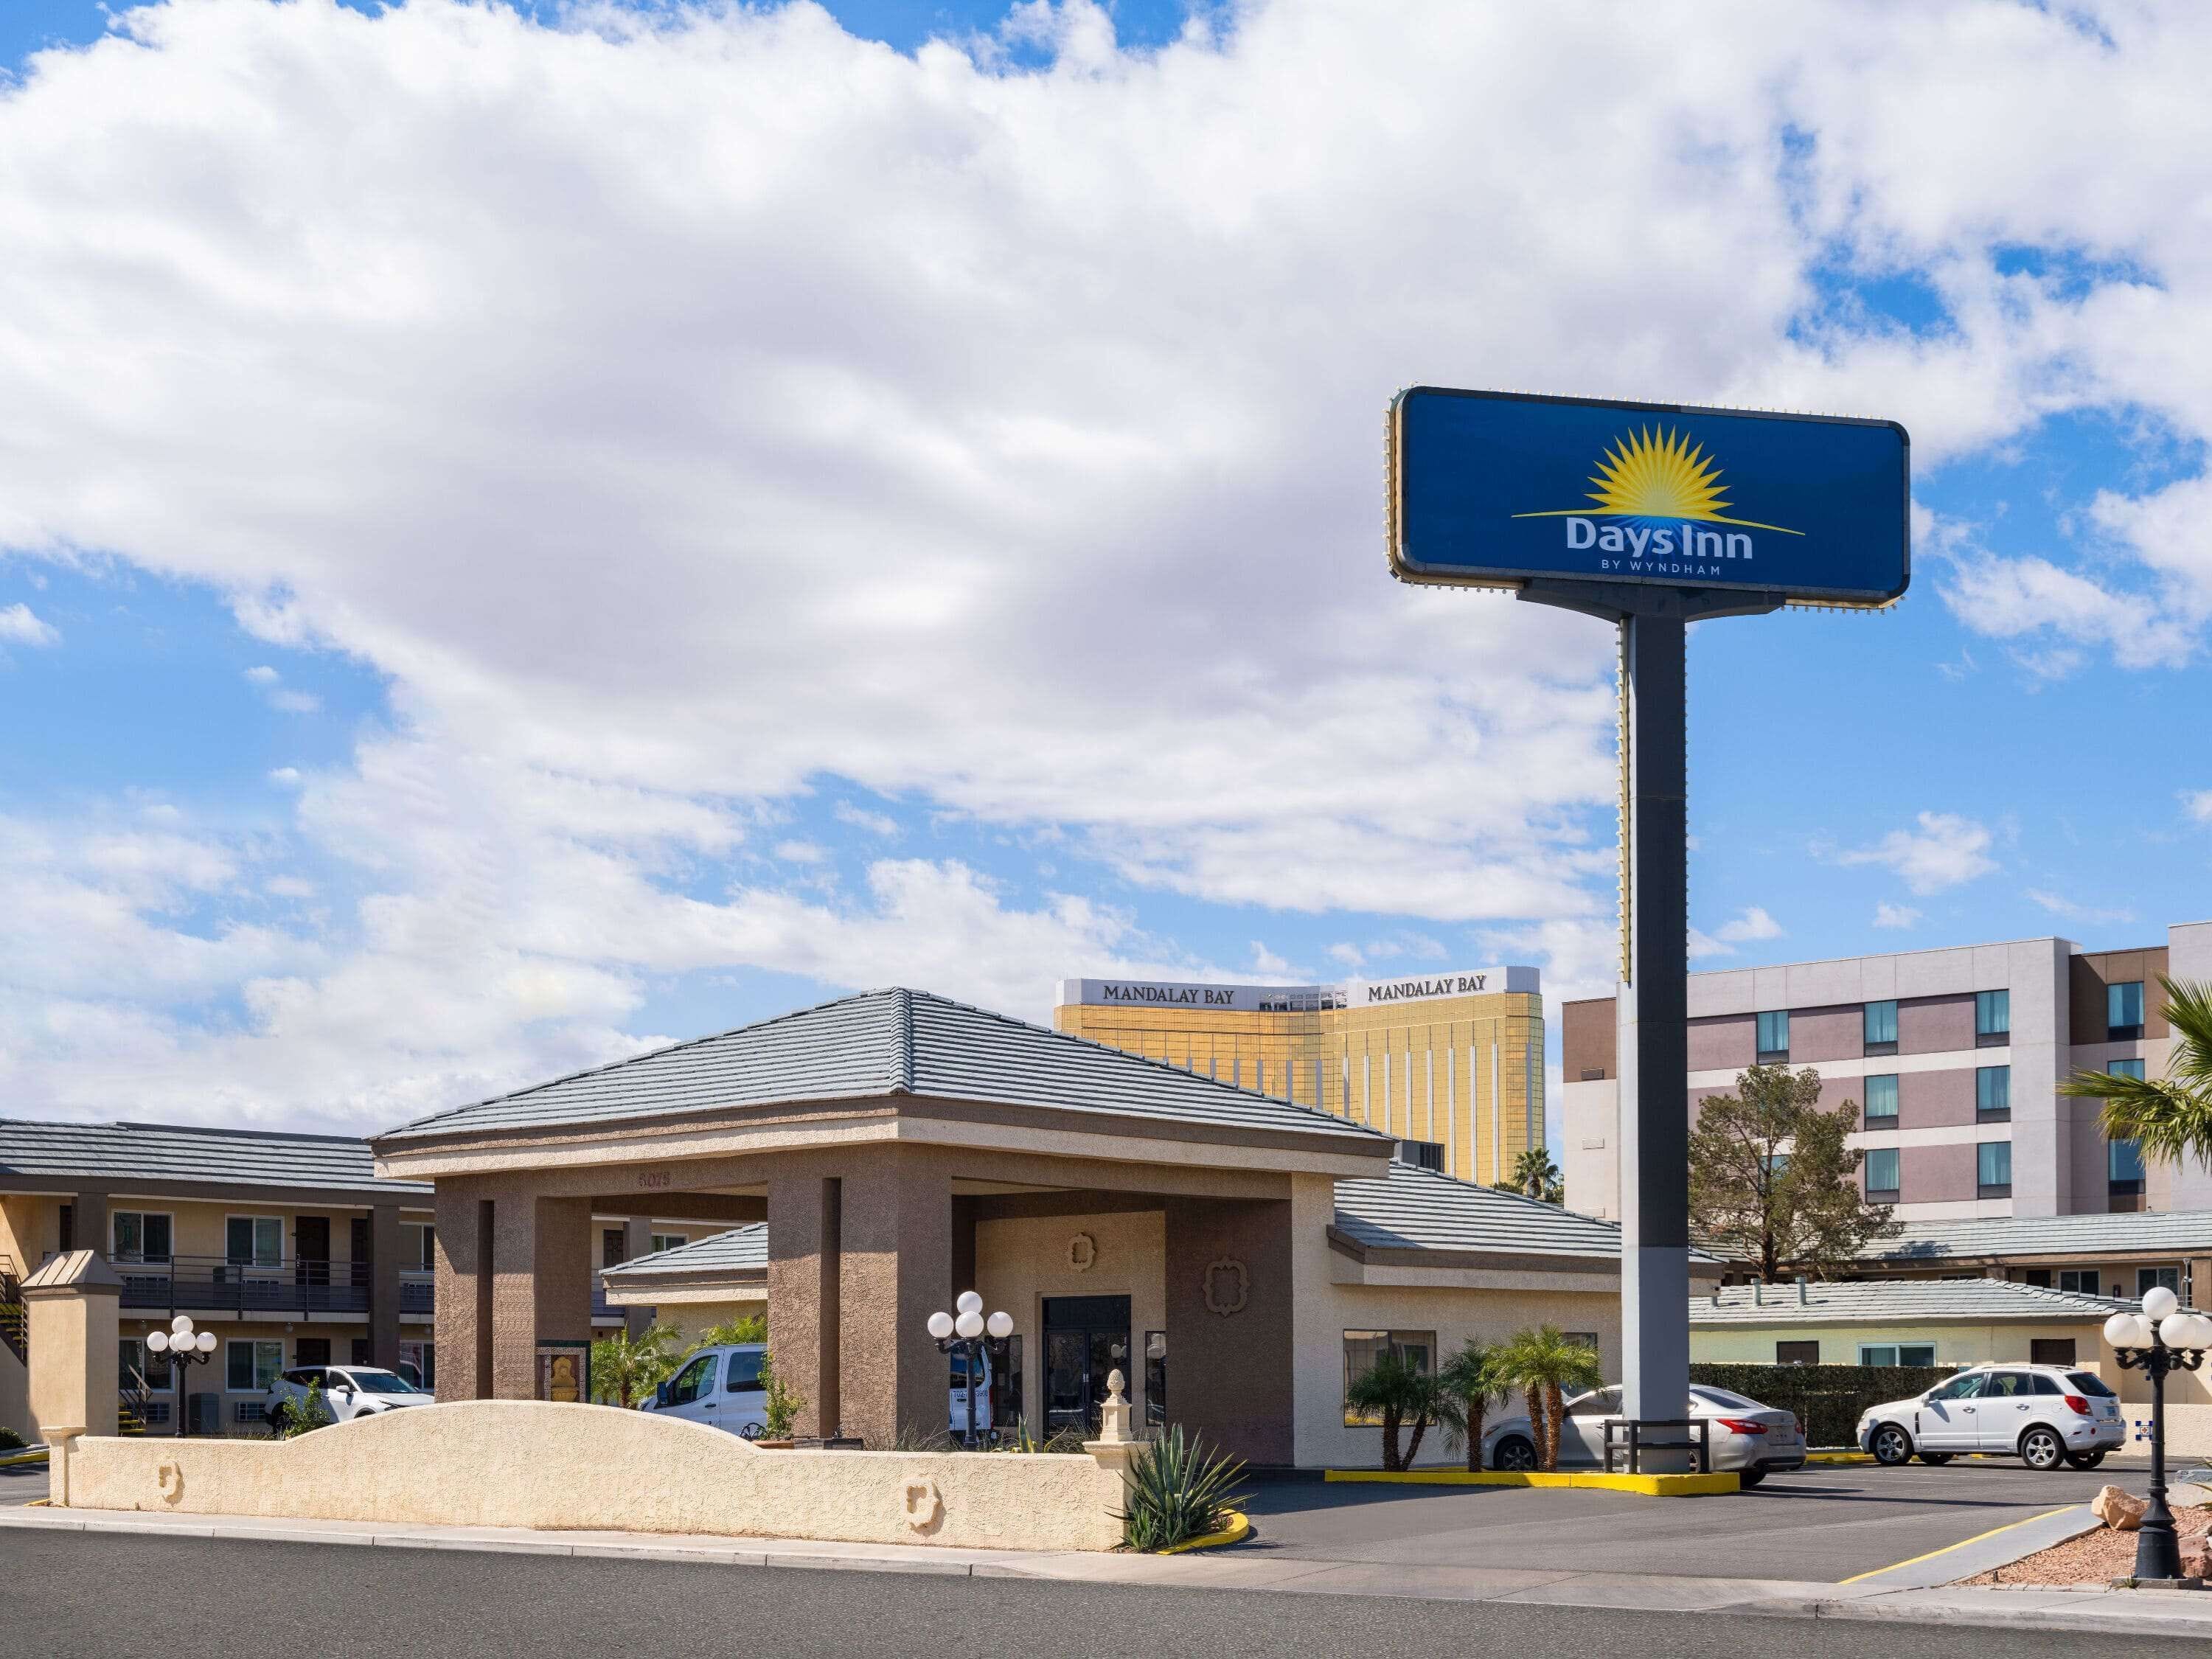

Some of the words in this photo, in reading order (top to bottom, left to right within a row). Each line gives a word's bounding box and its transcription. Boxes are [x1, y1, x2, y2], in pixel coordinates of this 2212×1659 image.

[1566, 517, 1674, 558] Days
[1682, 524, 1753, 559] Inn
[1601, 559, 1621, 570] BY
[1630, 560, 1721, 575] WYNDHAM
[1103, 985, 1200, 1004] MANDALAY
[1203, 990, 1234, 1004] BAY
[1368, 978, 1454, 1002] MANDALAY
[1457, 974, 1486, 992] BAY
